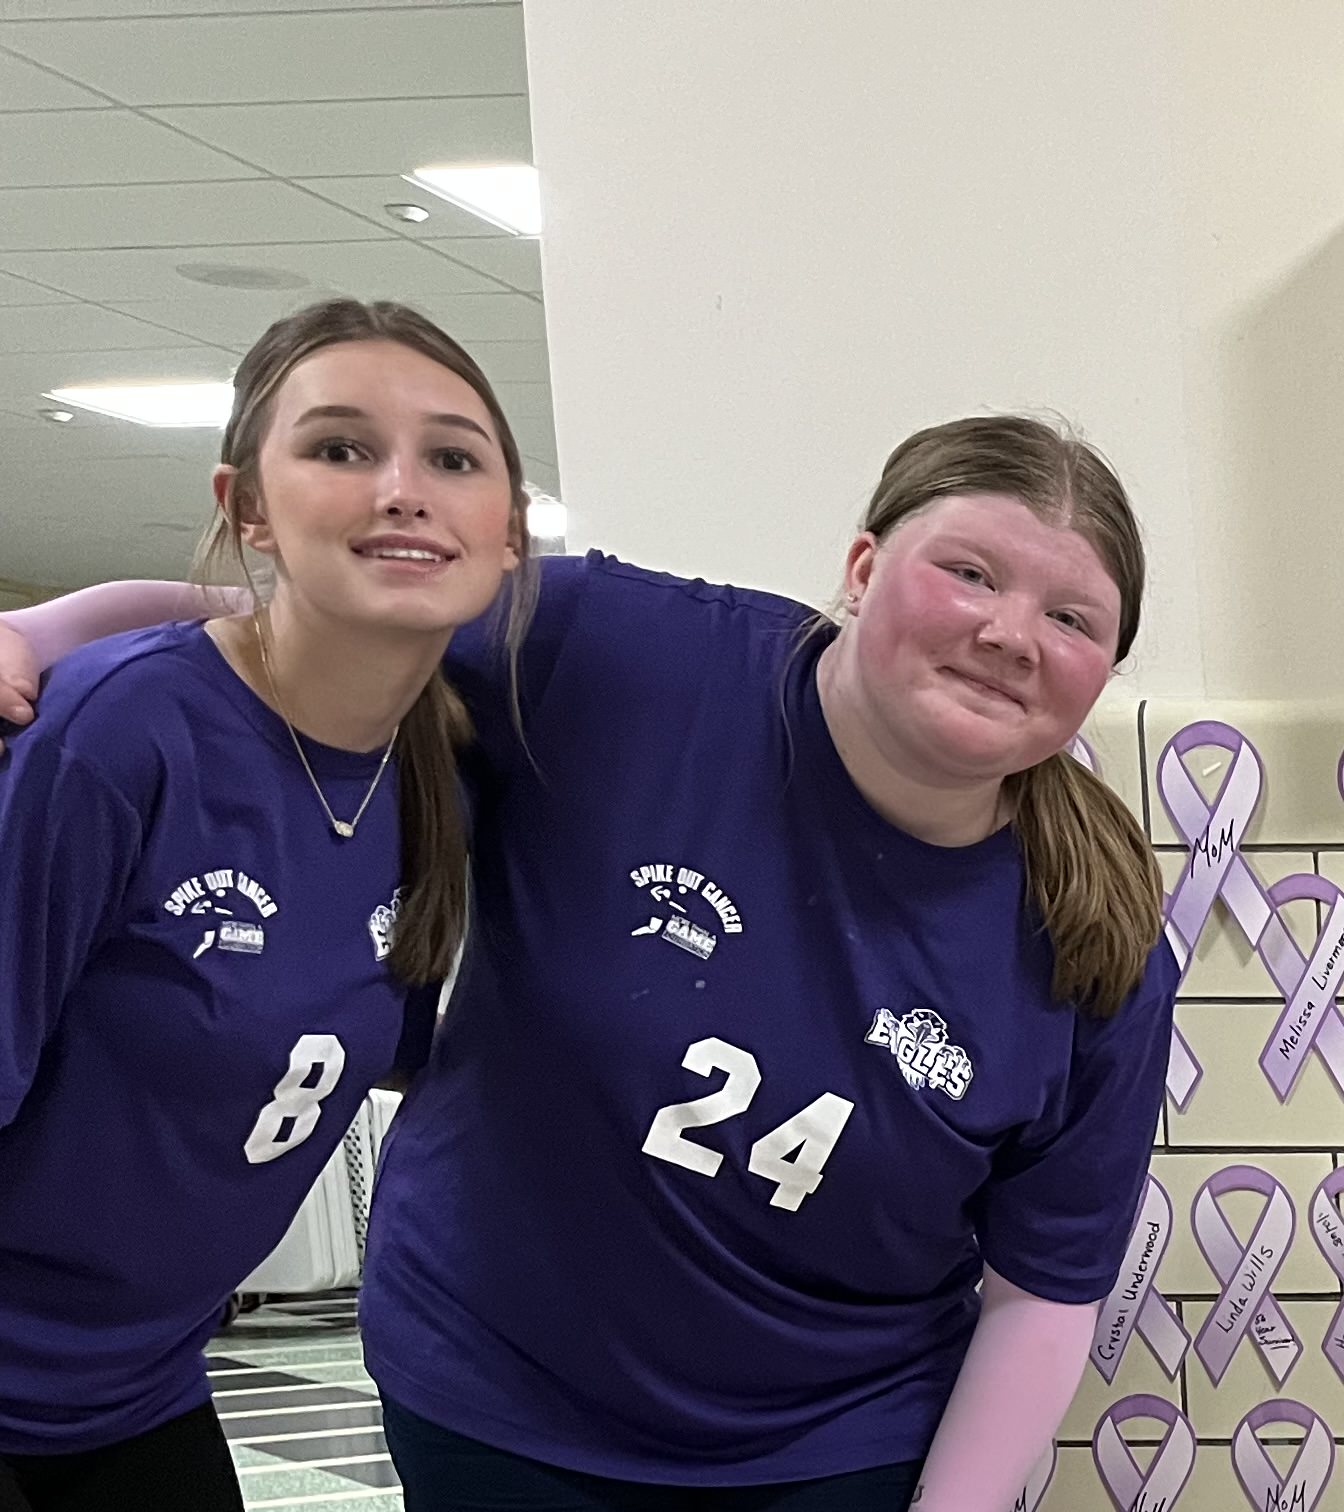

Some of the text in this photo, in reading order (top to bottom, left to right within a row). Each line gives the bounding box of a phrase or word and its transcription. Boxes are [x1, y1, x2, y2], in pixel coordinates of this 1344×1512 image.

[164, 877, 206, 916] SPIKE
[630, 864, 743, 934] SPIKE OUT CANCER
[665, 920, 717, 953] GAME
[865, 1010, 973, 1100] EAGLES
[1278, 1000, 1315, 1061] Melissa
[244, 1034, 345, 1164] 8
[641, 1037, 855, 1212] 24
[1123, 1221, 1160, 1301] Underwood
[1215, 1297, 1248, 1334] Linda
